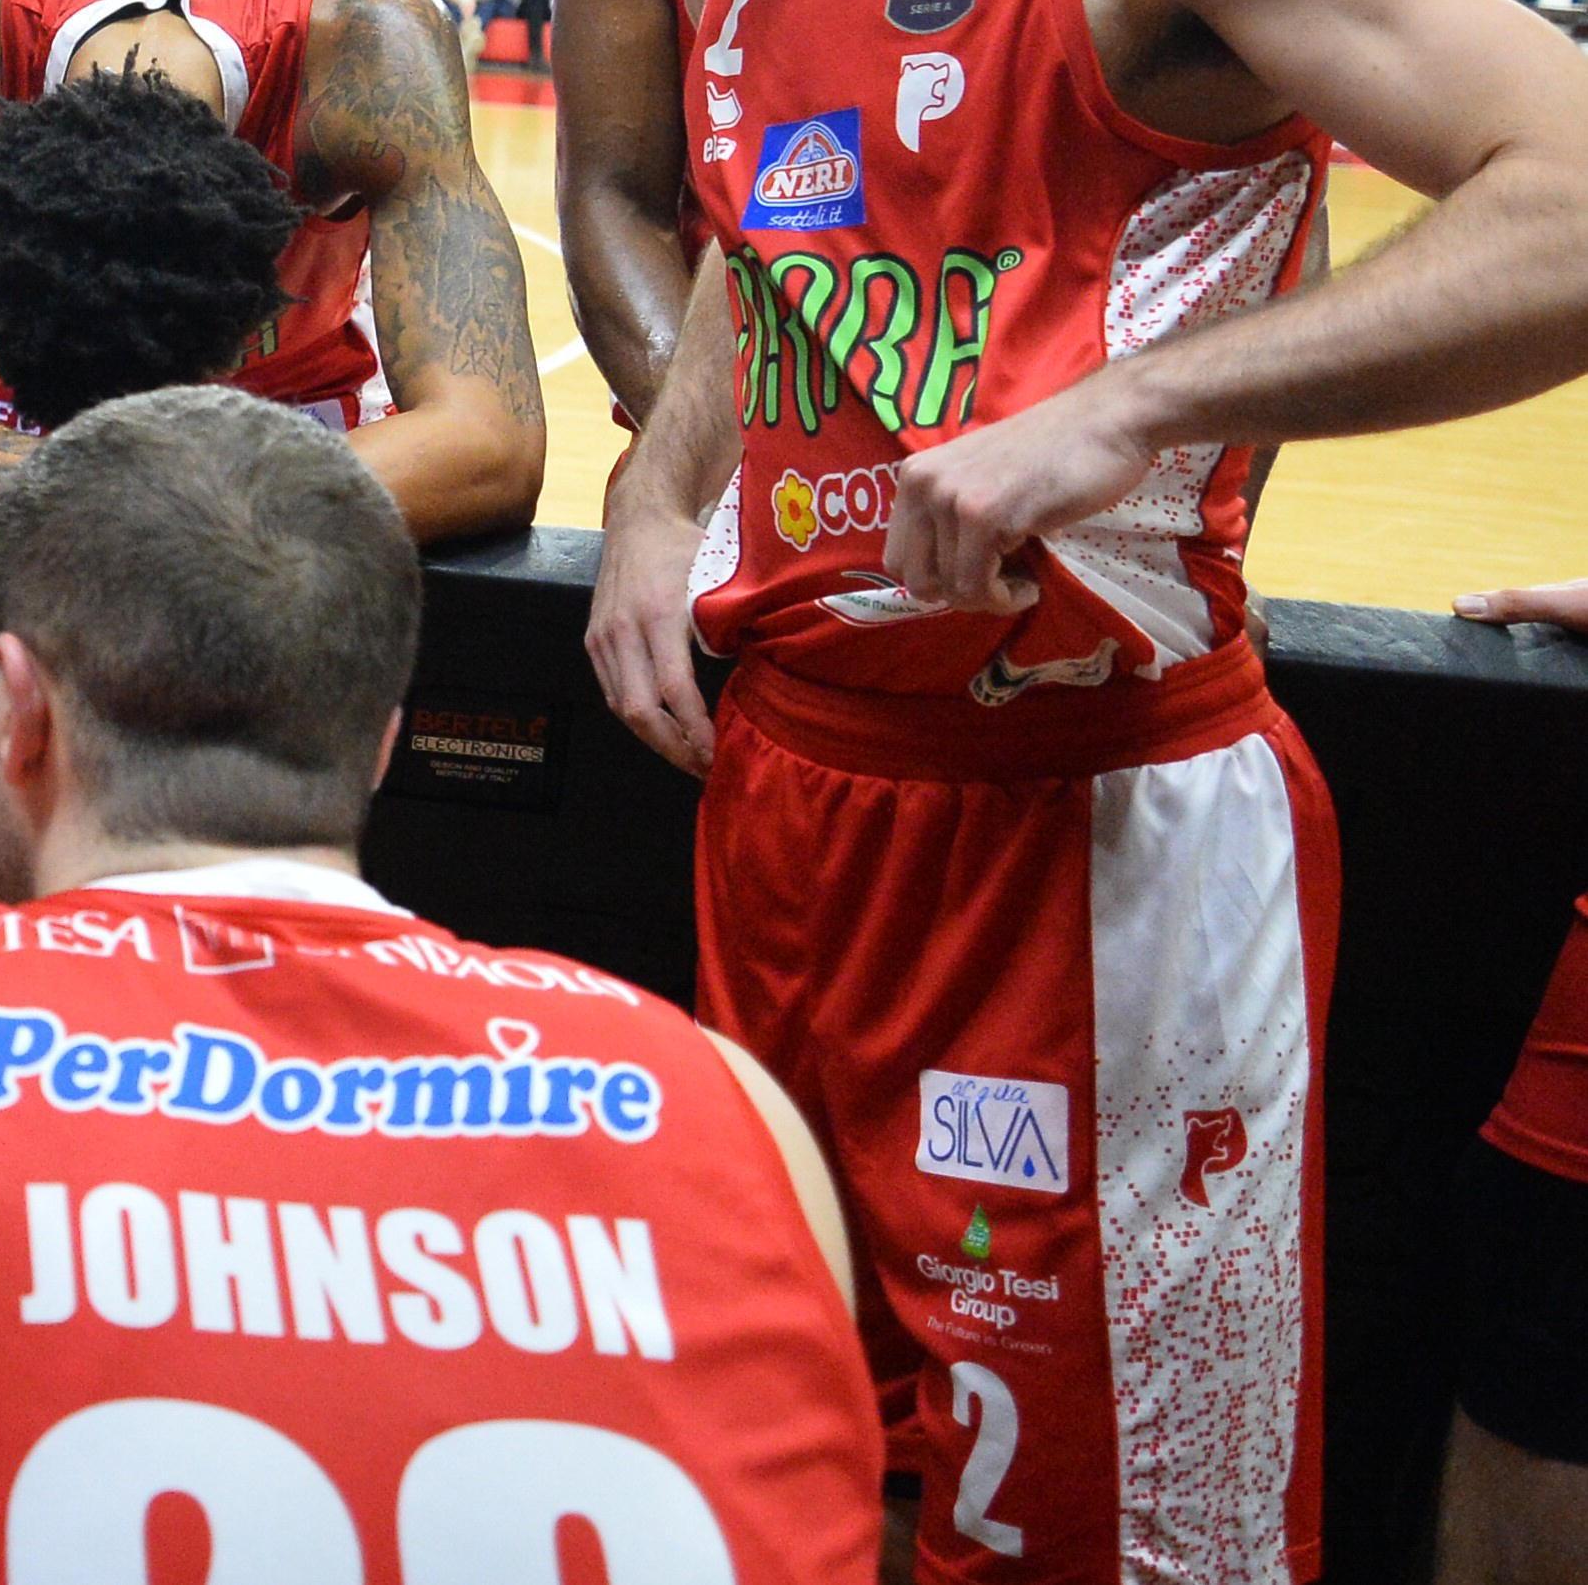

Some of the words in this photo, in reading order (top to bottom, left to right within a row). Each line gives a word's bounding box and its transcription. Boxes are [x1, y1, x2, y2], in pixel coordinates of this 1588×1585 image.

[909, 2, 944, 15] SERIE
[767, 158, 849, 199] NERI
[412, 736, 543, 762] ELECTRONICS
[951, 1079, 1031, 1121] acqua
[927, 1095, 1060, 1182] SILVA
[20, 1180, 677, 1363] JOHNSON
[916, 1254, 996, 1294] Giorgio
[998, 1268, 1060, 1302] Tesi
[927, 1316, 945, 1333] The
[945, 1319, 980, 1342] Future
[950, 1288, 1016, 1330] Group
[951, 1360, 1023, 1558] 2
